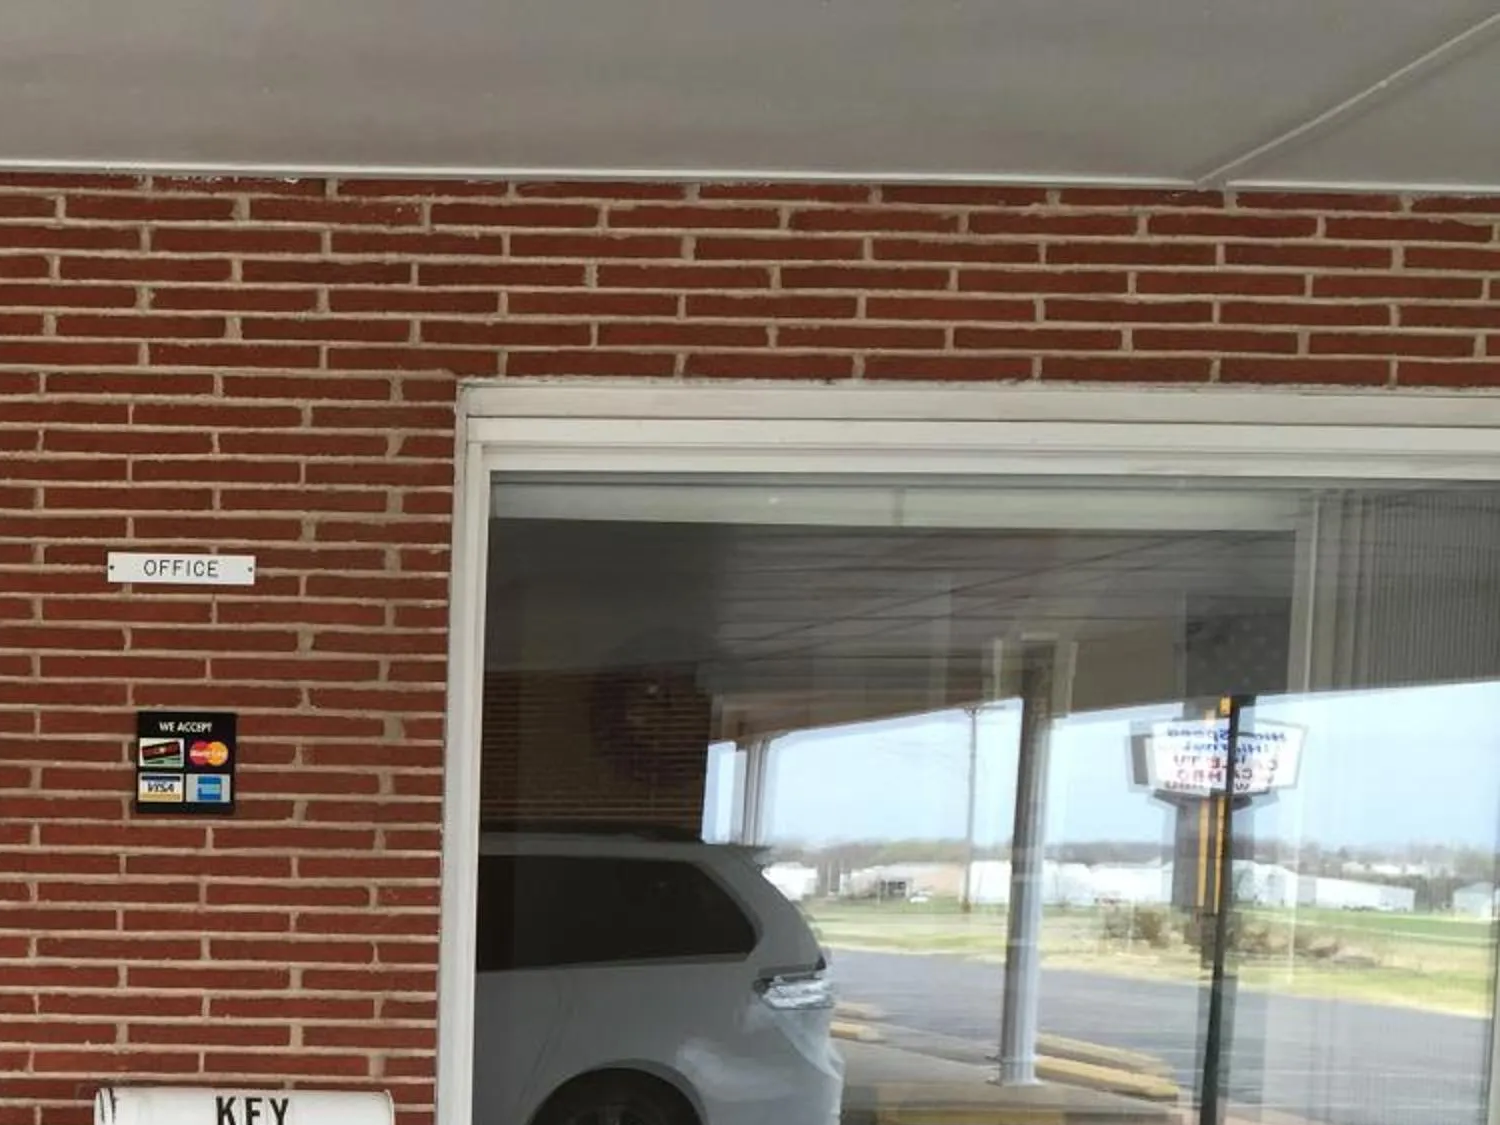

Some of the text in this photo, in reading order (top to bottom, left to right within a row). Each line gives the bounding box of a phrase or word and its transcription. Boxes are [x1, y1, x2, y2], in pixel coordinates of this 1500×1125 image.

[143, 559, 219, 577] OFFICE
[159, 722, 212, 732] WE ACCEPT
[147, 783, 175, 792] VISA
